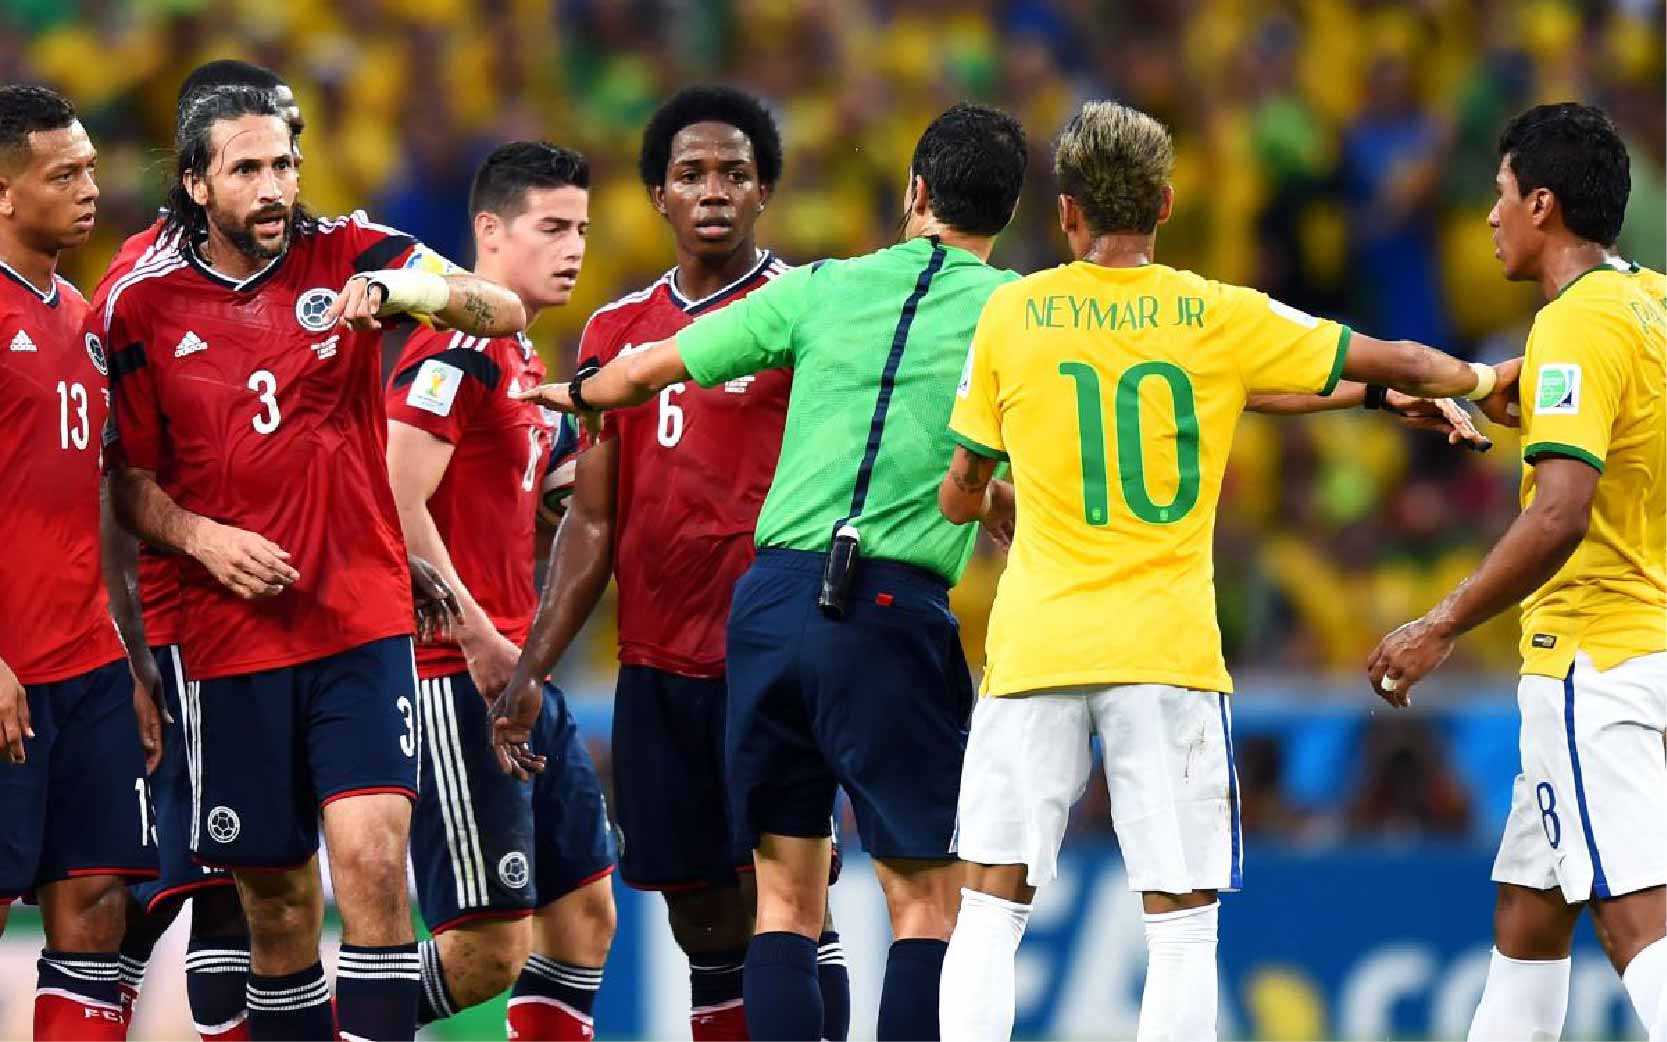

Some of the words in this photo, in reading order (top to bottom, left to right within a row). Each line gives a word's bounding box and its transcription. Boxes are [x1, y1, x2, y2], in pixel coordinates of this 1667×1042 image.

[1025, 295, 1159, 331] NEYMAR
[1168, 297, 1205, 329] JR
[56, 380, 90, 450] 13
[247, 369, 282, 435] 3
[657, 382, 687, 448] 6
[1057, 360, 1201, 527] 10
[395, 694, 416, 758] 3
[1536, 781, 1562, 850] 8
